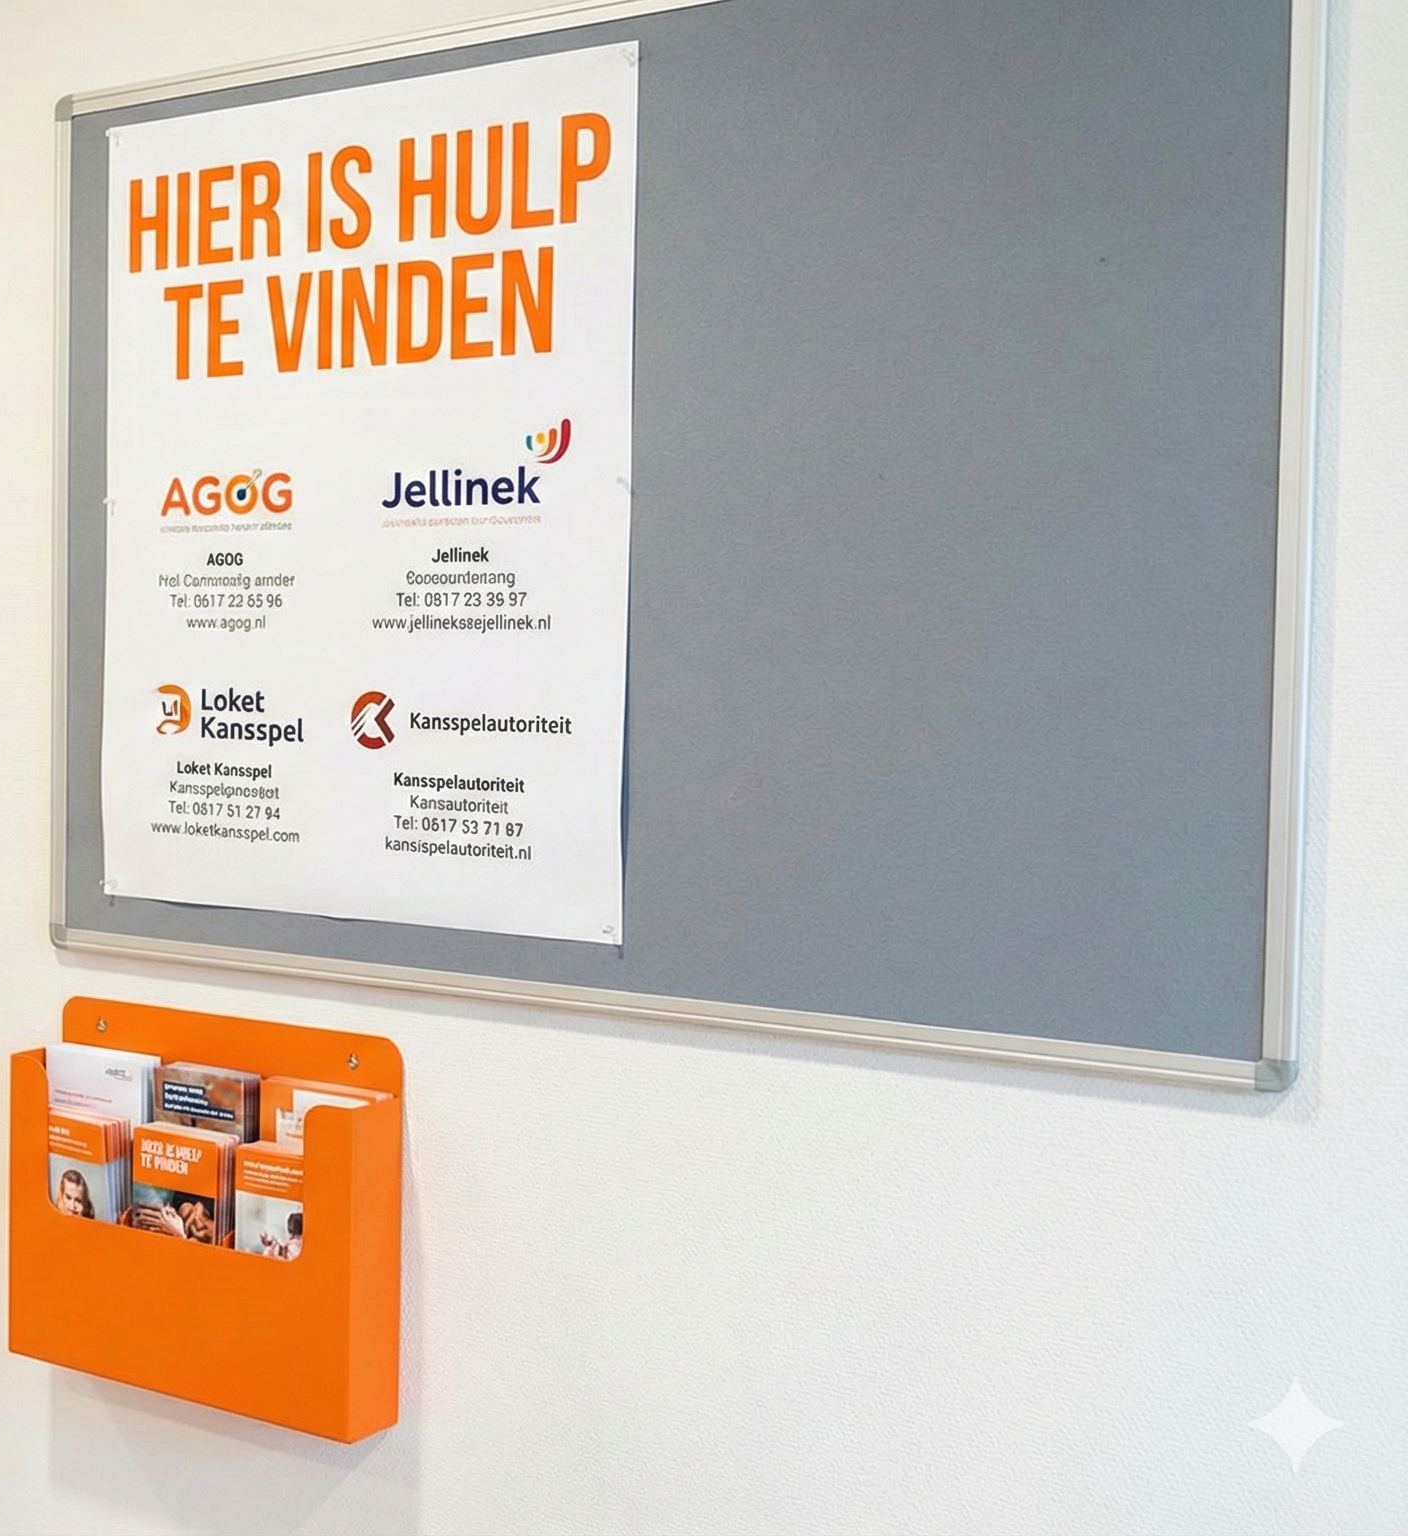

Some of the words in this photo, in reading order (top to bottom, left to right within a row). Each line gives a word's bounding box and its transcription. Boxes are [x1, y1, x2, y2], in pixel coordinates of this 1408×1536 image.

[128, 160, 282, 274] HIER
[306, 145, 372, 253] IS
[398, 112, 612, 243] HULP
[163, 279, 245, 381] TE
[266, 246, 555, 374] VINDEN
[160, 471, 293, 517] AGOG
[381, 465, 541, 509] Jellinek
[206, 552, 244, 567] AGOG
[431, 546, 490, 564] Jellinek
[266, 593, 283, 609] 96
[395, 592, 420, 608] Tel:
[463, 592, 482, 608] 23
[201, 687, 265, 713] Loket
[200, 716, 305, 747] Kansspel
[410, 712, 573, 736] Kansspelautoriteit
[176, 760, 211, 775] Loket
[214, 762, 272, 782] Kansspel
[393, 771, 525, 794] Kansspelautoriteit
[245, 804, 261, 820] 27
[264, 806, 281, 821] 94
[409, 795, 509, 815] Kansautoriteit
[393, 814, 419, 831] Tel:
[482, 820, 500, 836] 71
